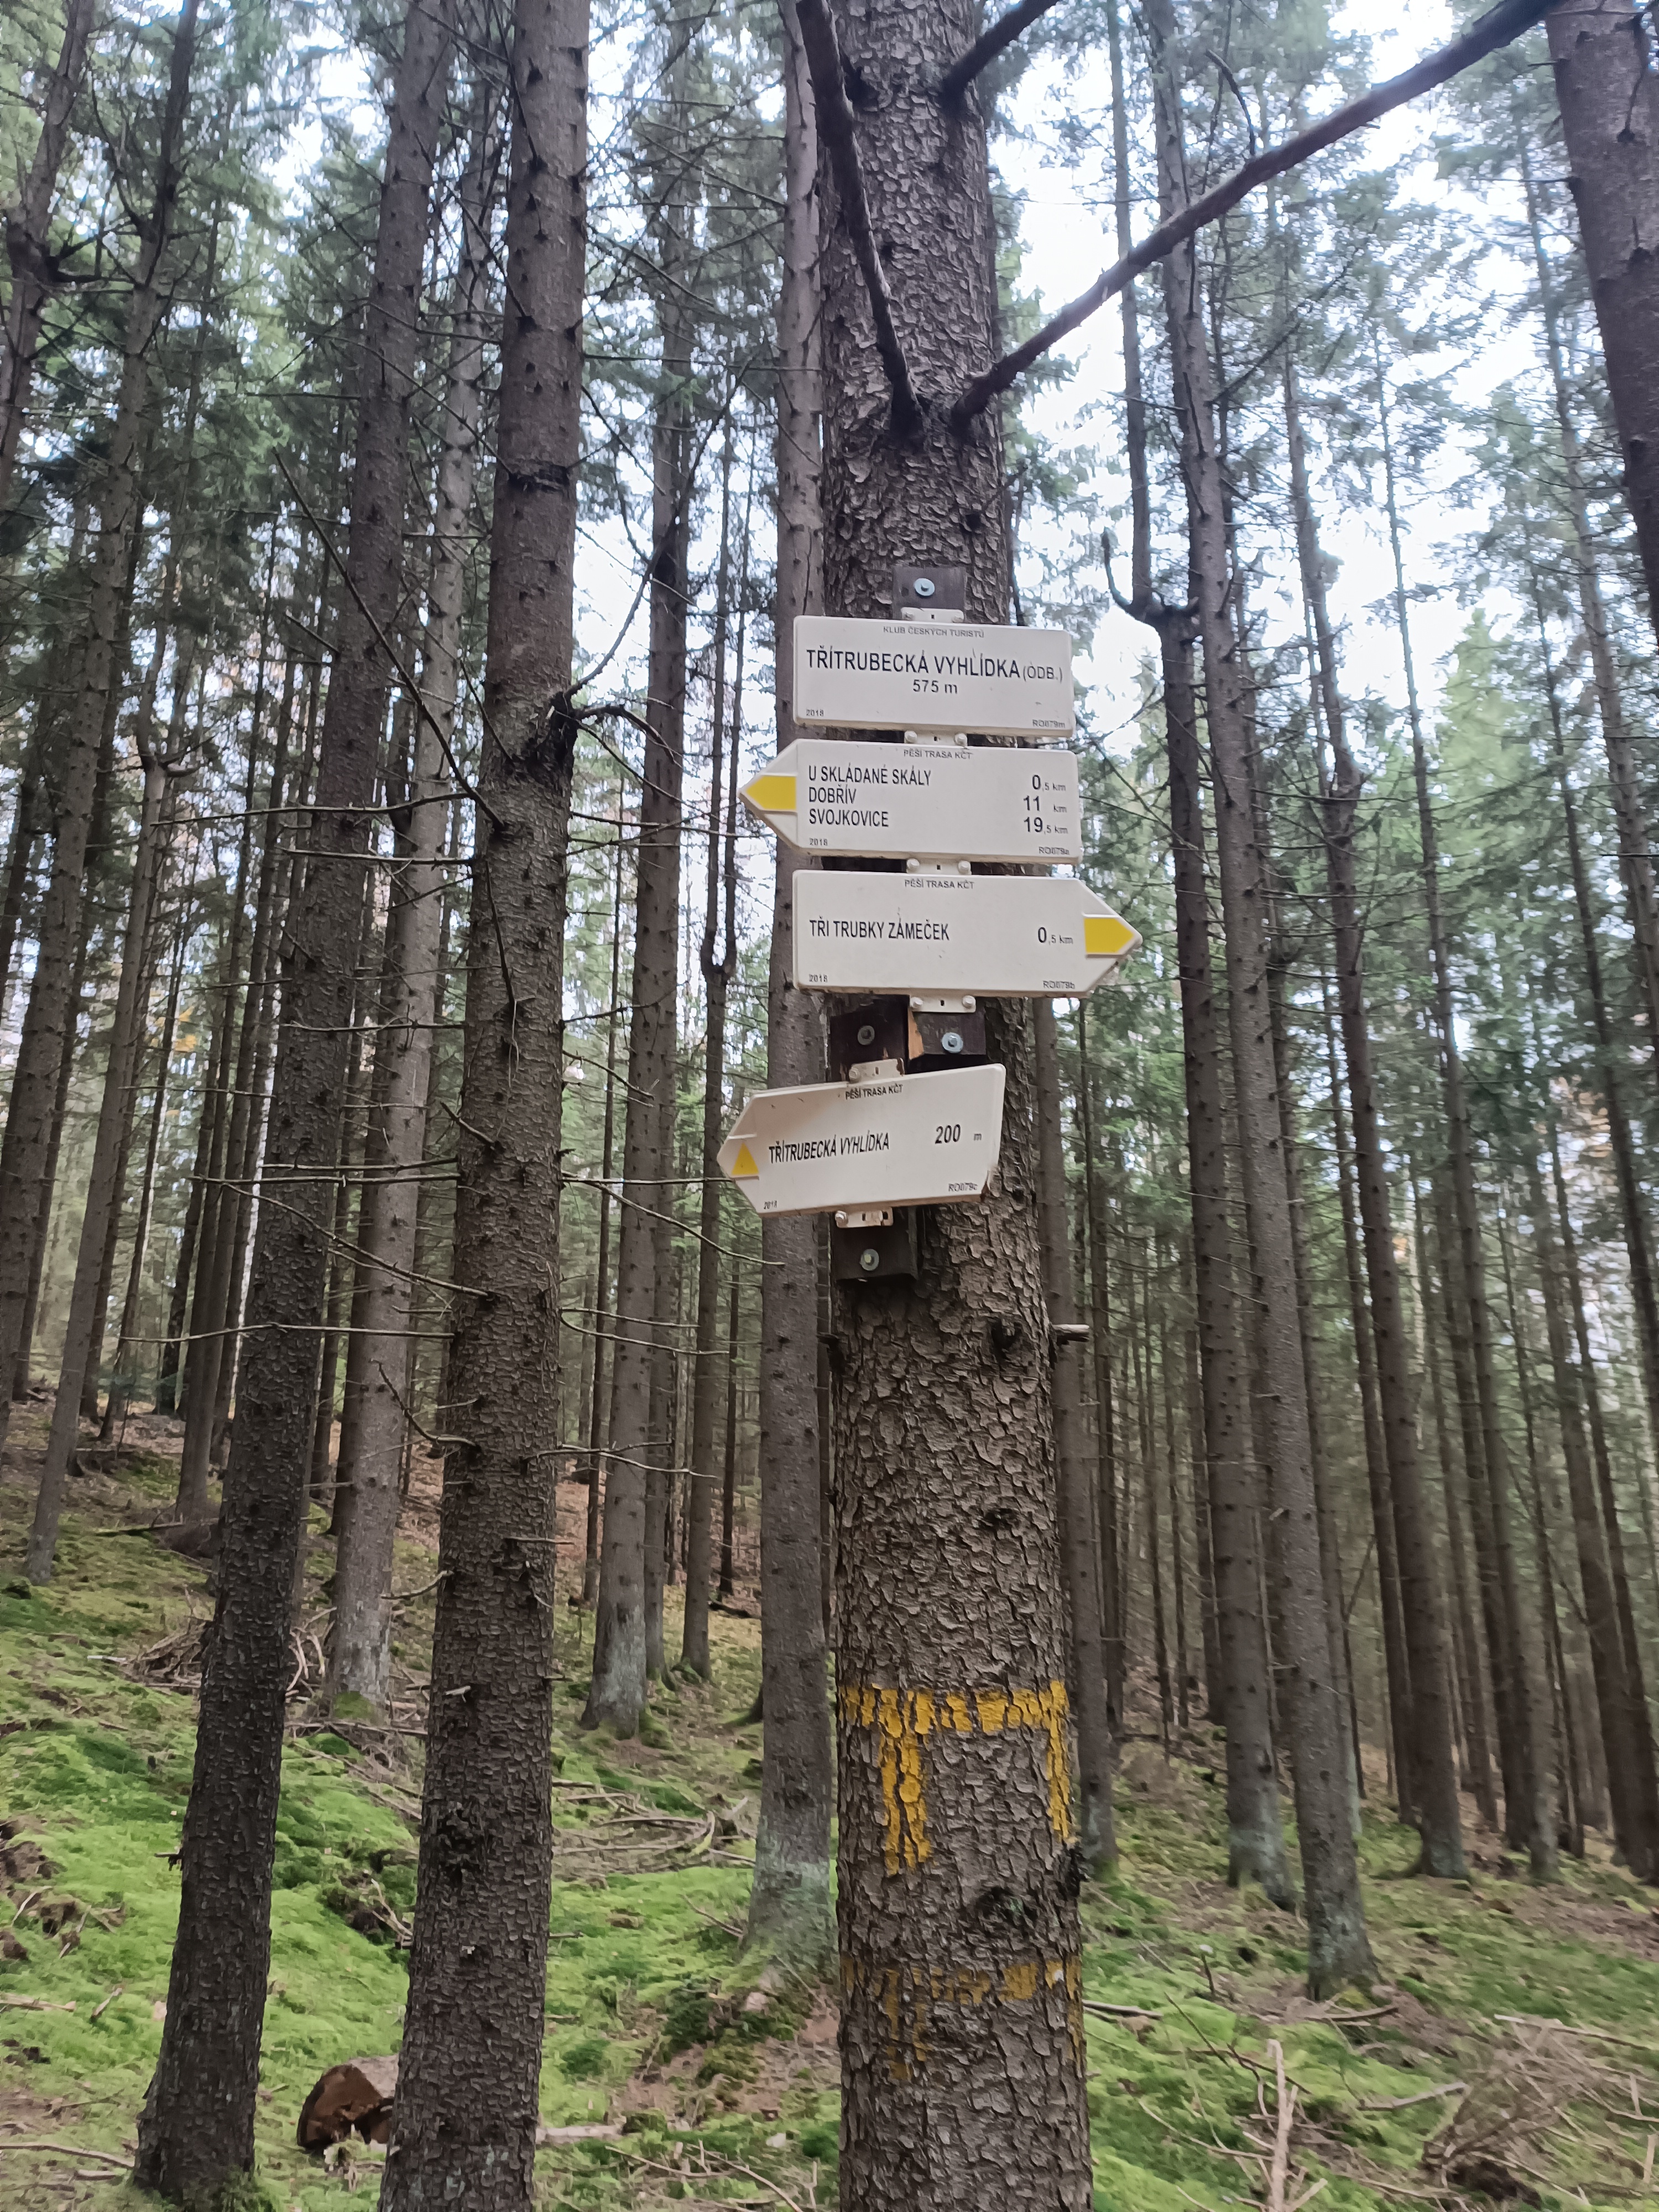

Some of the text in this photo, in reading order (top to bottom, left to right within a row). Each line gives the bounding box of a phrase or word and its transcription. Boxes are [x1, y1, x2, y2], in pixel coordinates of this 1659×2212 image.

[884, 625, 984, 638] KLUB ČESKÝCH TURISTŮ
[806, 645, 1063, 684] TŘÍTRUBECKÁ VYHLÍDKA (ODB.)
[913, 679, 958, 694] 575 m
[806, 708, 824, 717] 2018
[904, 748, 972, 759] PĚŠÍ TRASA KČT
[808, 762, 931, 786] U SKLÁDANÉ SKÁLY
[1032, 774, 1066, 791] 0,5 km
[809, 784, 857, 804] DOBŘÍV
[1023, 795, 1067, 813] 11 km
[809, 808, 889, 827] SVOJKOVICE
[1024, 816, 1068, 834] 19,5 km
[809, 837, 828, 846] 2018
[904, 879, 975, 889] PĚŠÍ TRASA KČT
[809, 915, 950, 941] TŘI TRUBKY ZÁMEČEK
[1037, 927, 1073, 945] 0,5 km
[808, 974, 828, 983] 2018
[845, 1082, 903, 1100] PĚŠÍ TRASA KČT
[935, 1124, 982, 1144] 200 m
[769, 1130, 890, 1164] TŘÍTRUBECKÁ VYHLÍDKA
[763, 1200, 778, 1210] 2018
